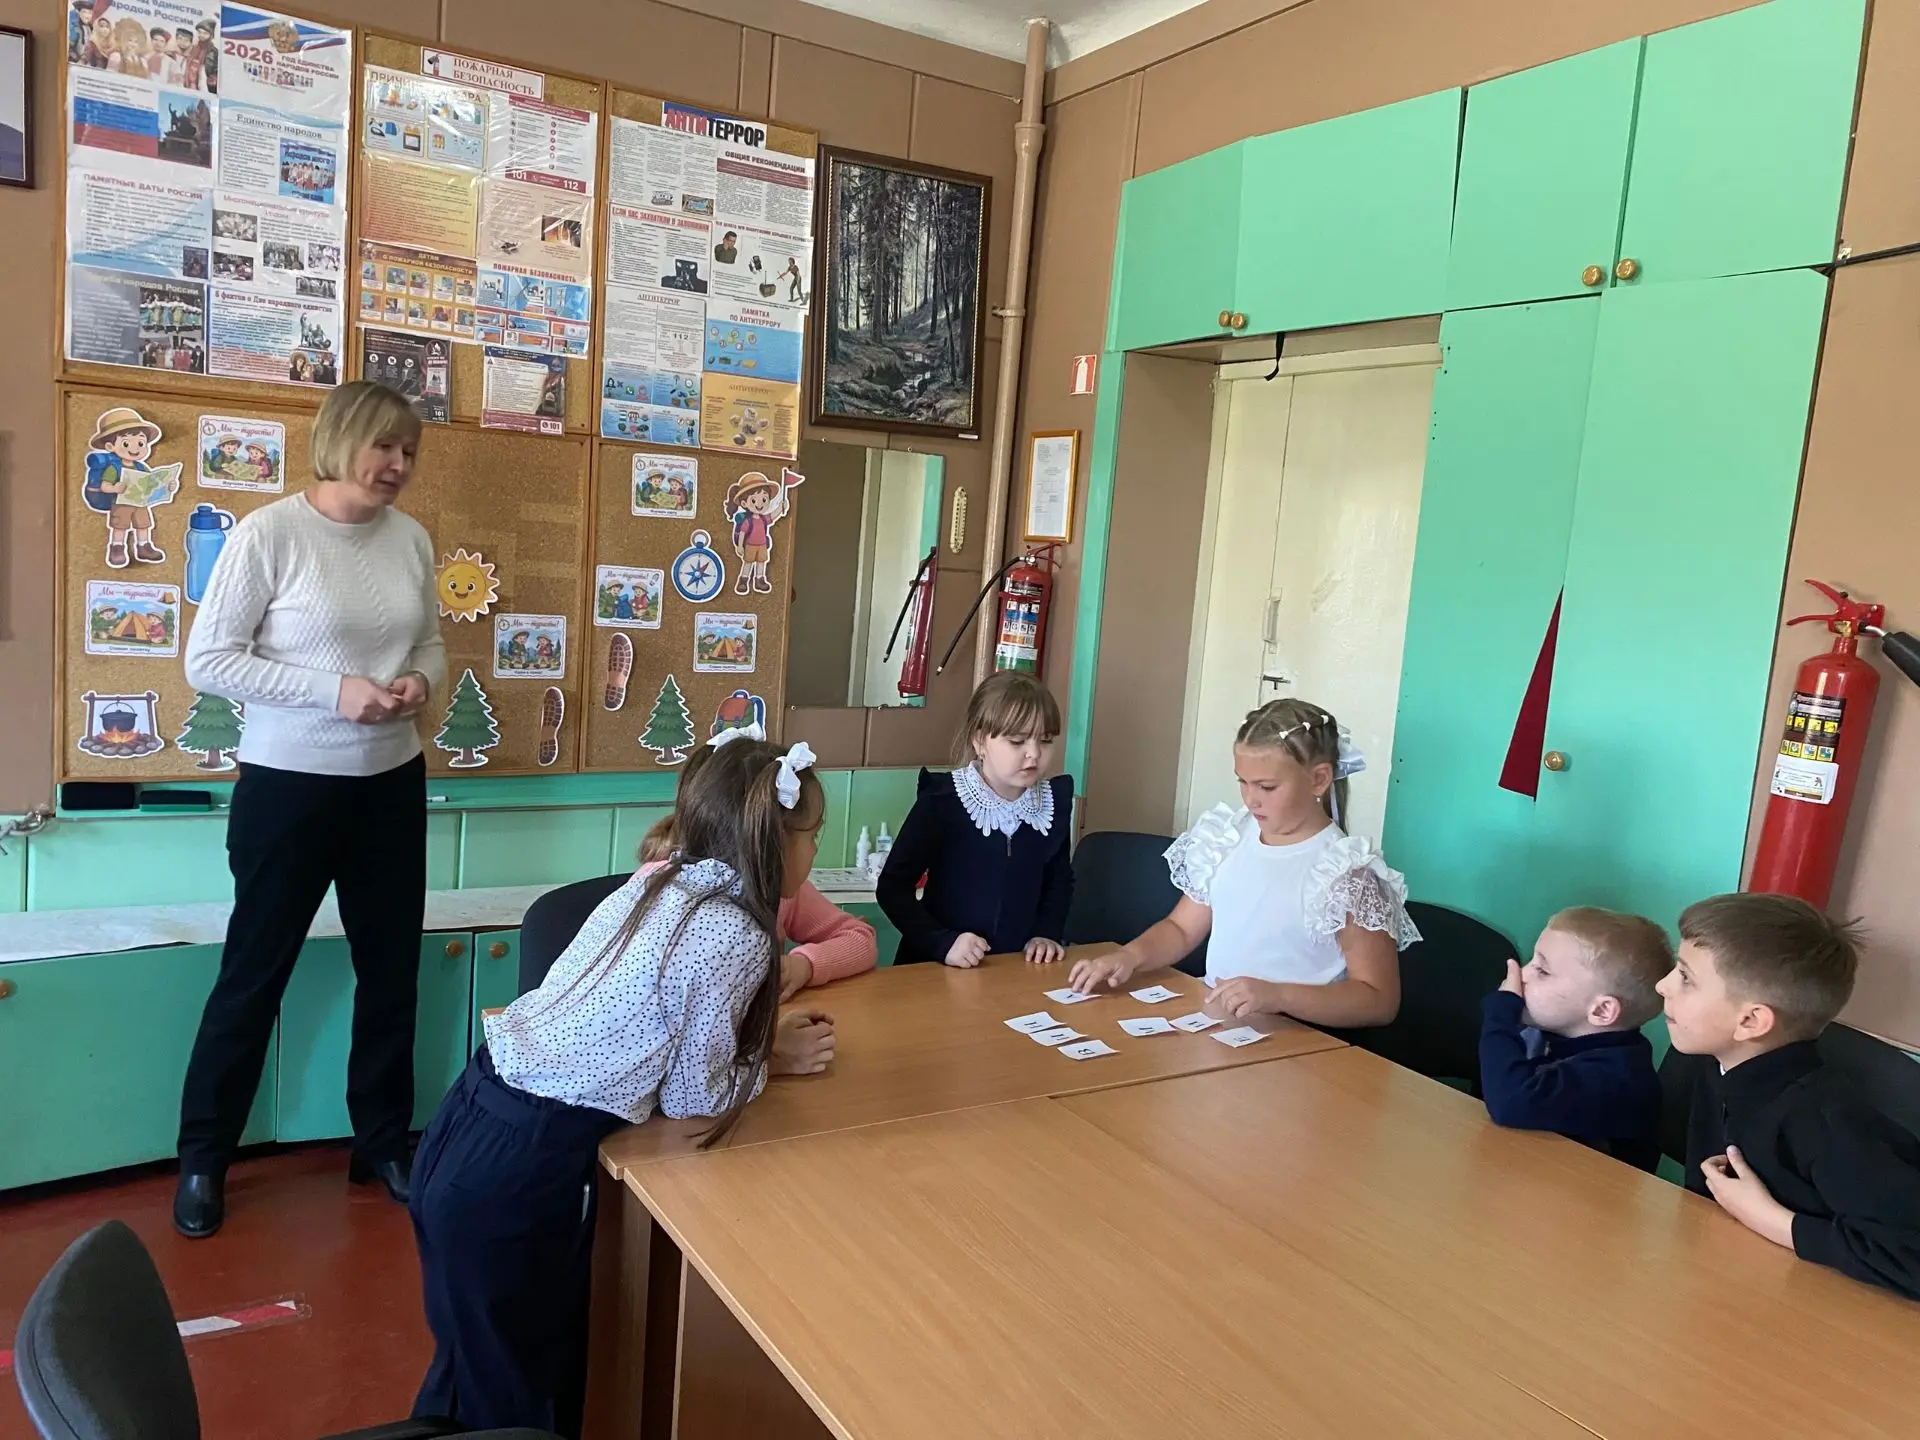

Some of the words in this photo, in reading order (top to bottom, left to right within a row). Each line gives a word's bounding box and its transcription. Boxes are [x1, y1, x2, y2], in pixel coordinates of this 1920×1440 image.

[111, 1, 151, 16] ародов
[154, 9, 194, 26] России
[224, 41, 273, 65] 2026
[276, 61, 310, 73] НАРОДОВ
[311, 69, 339, 79] РОССИИ
[281, 55, 296, 64] ГОД
[297, 58, 335, 72] ЕДИНСТВА
[453, 58, 513, 79] ПОЖАРНАЯ
[453, 70, 535, 96] БЕЗОПАСНОСТЬ
[237, 114, 282, 131] Единство
[284, 126, 322, 139] народов
[725, 151, 751, 161] ОБЩИЕ
[752, 156, 806, 173] РЕКОМЕНДАЦИИ
[84, 174, 135, 188] ПАМЯТНЫЕ
[139, 183, 164, 193] ДАТЫ
[167, 188, 203, 200] РОССИИ
[512, 171, 527, 180] 101
[564, 180, 579, 190] 112
[612, 207, 626, 216] ЕСЛИ
[628, 210, 639, 219] ВАС
[389, 256, 424, 267] ПОЖАРНОЙ
[425, 262, 473, 275] БЕЗОПАСНОСТИ
[418, 253, 439, 261] ДЕТЯМ
[493, 263, 527, 274] ПОЖАРНАЯ
[530, 270, 577, 283] БЕЗОПАСНОСТЬ
[166, 283, 199, 295] России
[740, 316, 781, 328] АНТИТЕРРОРУ
[742, 308, 770, 317] ПАМЯТКА
[550, 422, 560, 430] 101
